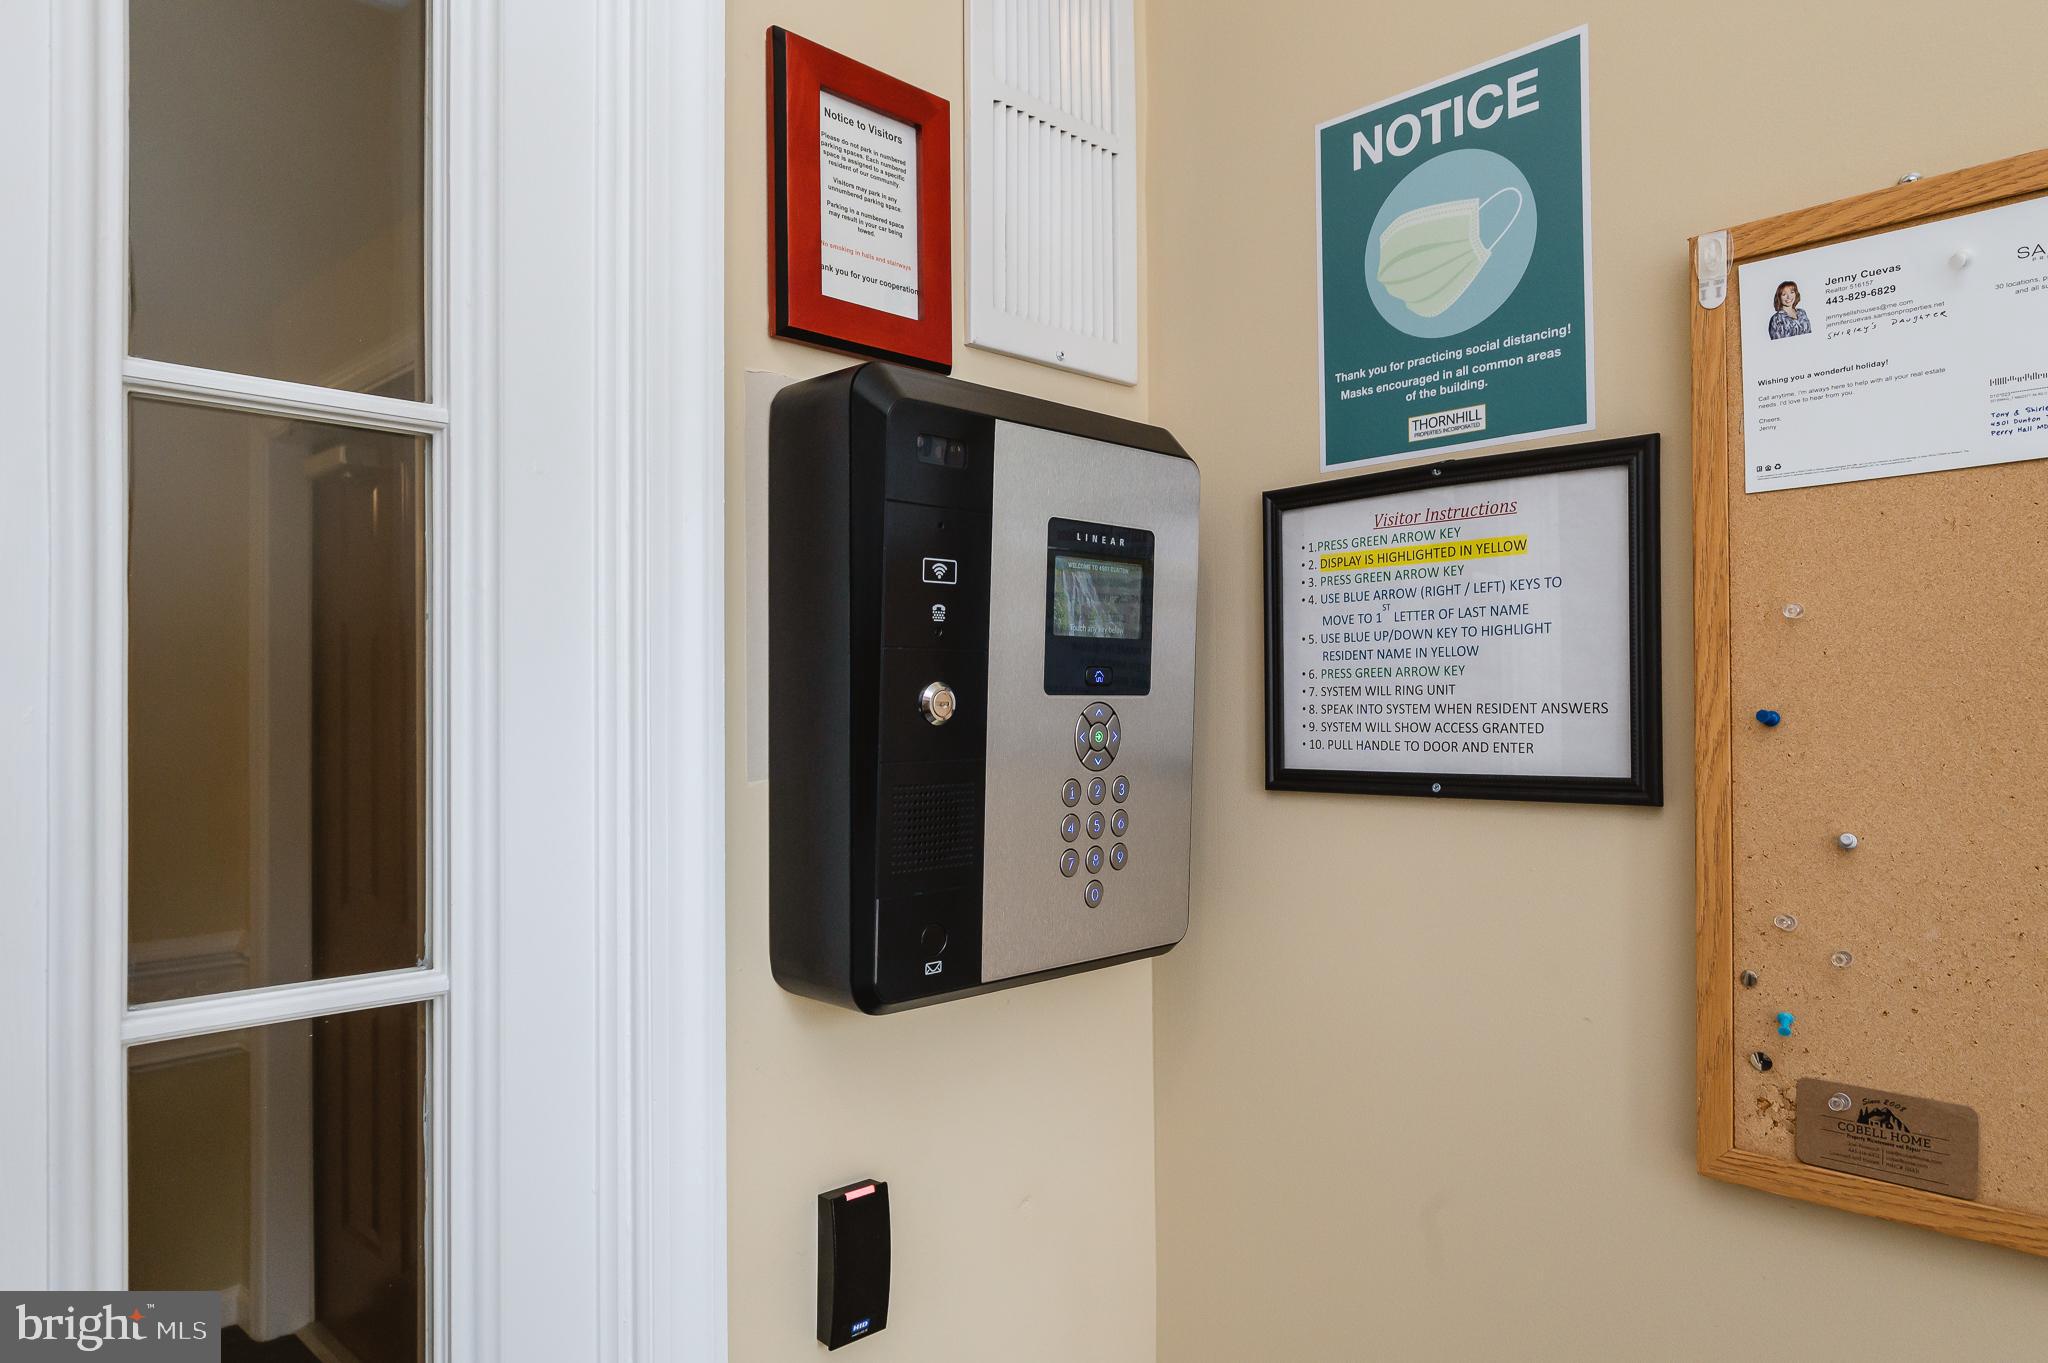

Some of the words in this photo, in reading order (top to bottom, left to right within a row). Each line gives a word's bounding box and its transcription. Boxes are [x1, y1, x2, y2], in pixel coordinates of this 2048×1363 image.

[824, 107, 854, 126] Notice
[857, 120, 865, 130] to
[868, 124, 902, 144] Visitors
[1352, 68, 1540, 171] NOTICE
[821, 131, 839, 142] Please
[880, 153, 906, 165] numbered
[833, 177, 854, 189] Visitors
[856, 185, 867, 194] may
[869, 189, 880, 197] park
[827, 200, 848, 212] Parking
[861, 211, 887, 224] numbered
[889, 220, 904, 229] space
[835, 268, 848, 276] you
[851, 271, 860, 279] for
[862, 275, 877, 284] your
[1825, 273, 1857, 285] Jenny
[1861, 265, 1901, 278] Cuevas
[1825, 284, 1848, 294] Realtor
[1826, 285, 1896, 305] 443-829-6829
[1335, 369, 1366, 383] Thank
[1369, 366, 1387, 378] you
[1389, 362, 1405, 371] for
[1408, 349, 1462, 370] practicing
[1466, 339, 1500, 355] social
[1503, 323, 1571, 347] distancing!
[1341, 387, 1373, 400] Masks
[1376, 372, 1439, 393] encouraged
[1443, 370, 1452, 379] in
[1456, 366, 1468, 377] all
[1472, 356, 1523, 373] common
[1527, 349, 1561, 363] areas
[1758, 375, 1789, 386] Wishing
[1791, 373, 1804, 382] you
[1814, 365, 1854, 377] wonderful
[1856, 360, 1889, 370] holiday!
[1406, 391, 1416, 401] of
[1419, 388, 1436, 398] the
[1440, 379, 1488, 395] building.
[1412, 409, 1482, 431] THORNHILL
[1414, 429, 1442, 438] PROPERTIES
[1442, 422, 1480, 434] INCORPORATED
[1373, 512, 1421, 528] Visitor
[1425, 501, 1517, 522] Instructions
[1077, 533, 1125, 546] LINEAR
[1351, 535, 1388, 548] GREEN
[1391, 530, 1436, 544] ARROW
[1440, 527, 1461, 539] KEY
[1309, 560, 1317, 570] 2.
[1320, 555, 1361, 569] DISPLAY
[1365, 554, 1373, 564] IS
[1377, 546, 1456, 563] HIGHLIGHTED
[1460, 545, 1472, 556] IN
[1476, 539, 1528, 554] YELLOW
[1308, 577, 1317, 587] 3.
[1320, 575, 1351, 586] PRESS
[1355, 572, 1391, 584] GREEN
[1395, 567, 1439, 580] ARROW
[1443, 565, 1464, 576] KEY
[1308, 595, 1317, 605] 4.
[1321, 593, 1339, 604] USE
[1343, 591, 1370, 602] BLUE
[1373, 587, 1417, 600] ARROW
[1421, 584, 1461, 599] (RIGHT
[1464, 583, 1470, 596] /
[1473, 580, 1506, 594] LEFT)
[1510, 578, 1540, 591] KEYS
[1544, 576, 1562, 588] TO
[1322, 614, 1354, 626] MOVE
[1358, 613, 1372, 624] TO
[1394, 610, 1434, 622] LETTER
[1438, 608, 1454, 619] OF
[1458, 606, 1486, 618] LAST
[1490, 604, 1529, 617] NAME
[1308, 634, 1317, 644] 5.
[1321, 633, 1340, 644] USE
[1343, 632, 1370, 642] BLUE
[1374, 629, 1432, 642] UP/DOWN
[1436, 628, 1457, 638] KEY
[1461, 626, 1477, 638] TO
[1481, 622, 1552, 636] HIGHLIGHT
[1322, 649, 1373, 661] RESIDENT
[1377, 648, 1412, 659] NAME
[1415, 648, 1428, 658] IN
[1431, 646, 1479, 658] YELLOW
[1308, 669, 1318, 679] 6.
[1321, 668, 1351, 679] PRESS
[1355, 667, 1392, 678] GREEN
[1395, 666, 1440, 677] ARROW
[1444, 665, 1465, 676] KEY
[1309, 687, 1318, 696] 7.
[1321, 686, 1361, 696] SYSTEM
[1365, 685, 1391, 696] WILL
[1395, 685, 1423, 695] RING
[1427, 684, 1456, 696] UNIT
[1309, 705, 1318, 714] 8.
[1321, 704, 1353, 715] SPEAK
[1356, 704, 1383, 714] INTO
[1386, 704, 1430, 714] SYSTEM
[1434, 703, 1472, 714] WHEN
[1477, 703, 1537, 714] RESIDENT
[1541, 702, 1608, 714] ANSWERS
[1309, 722, 1318, 732] 9.
[1321, 722, 1361, 732] SYSTEM
[1365, 722, 1391, 732] WILL
[1394, 722, 1431, 733] SHOW
[1434, 722, 1478, 734] ACCESS
[1482, 722, 1544, 734] GRANTED
[1309, 740, 1324, 749] 10.
[1328, 740, 1353, 750] PULL
[1356, 741, 1401, 750] HANDLE
[1405, 741, 1419, 751] TO
[1423, 741, 1458, 752] DOOR
[1462, 742, 1489, 752] AND
[1493, 742, 1534, 753] ENTER
[1070, 787, 1074, 799] 1
[1095, 785, 1100, 797] 2
[1119, 784, 1124, 795] 3
[1068, 823, 1074, 833] 4
[1094, 820, 1100, 832] 5
[1118, 819, 1124, 829] 6
[1069, 858, 1074, 871] 7
[1093, 854, 1099, 865] 8
[1118, 852, 1123, 863] 9
[1092, 889, 1098, 901] 0
[1838, 1121, 1887, 1139] COBELL
[1891, 1132, 1931, 1148] HOME
